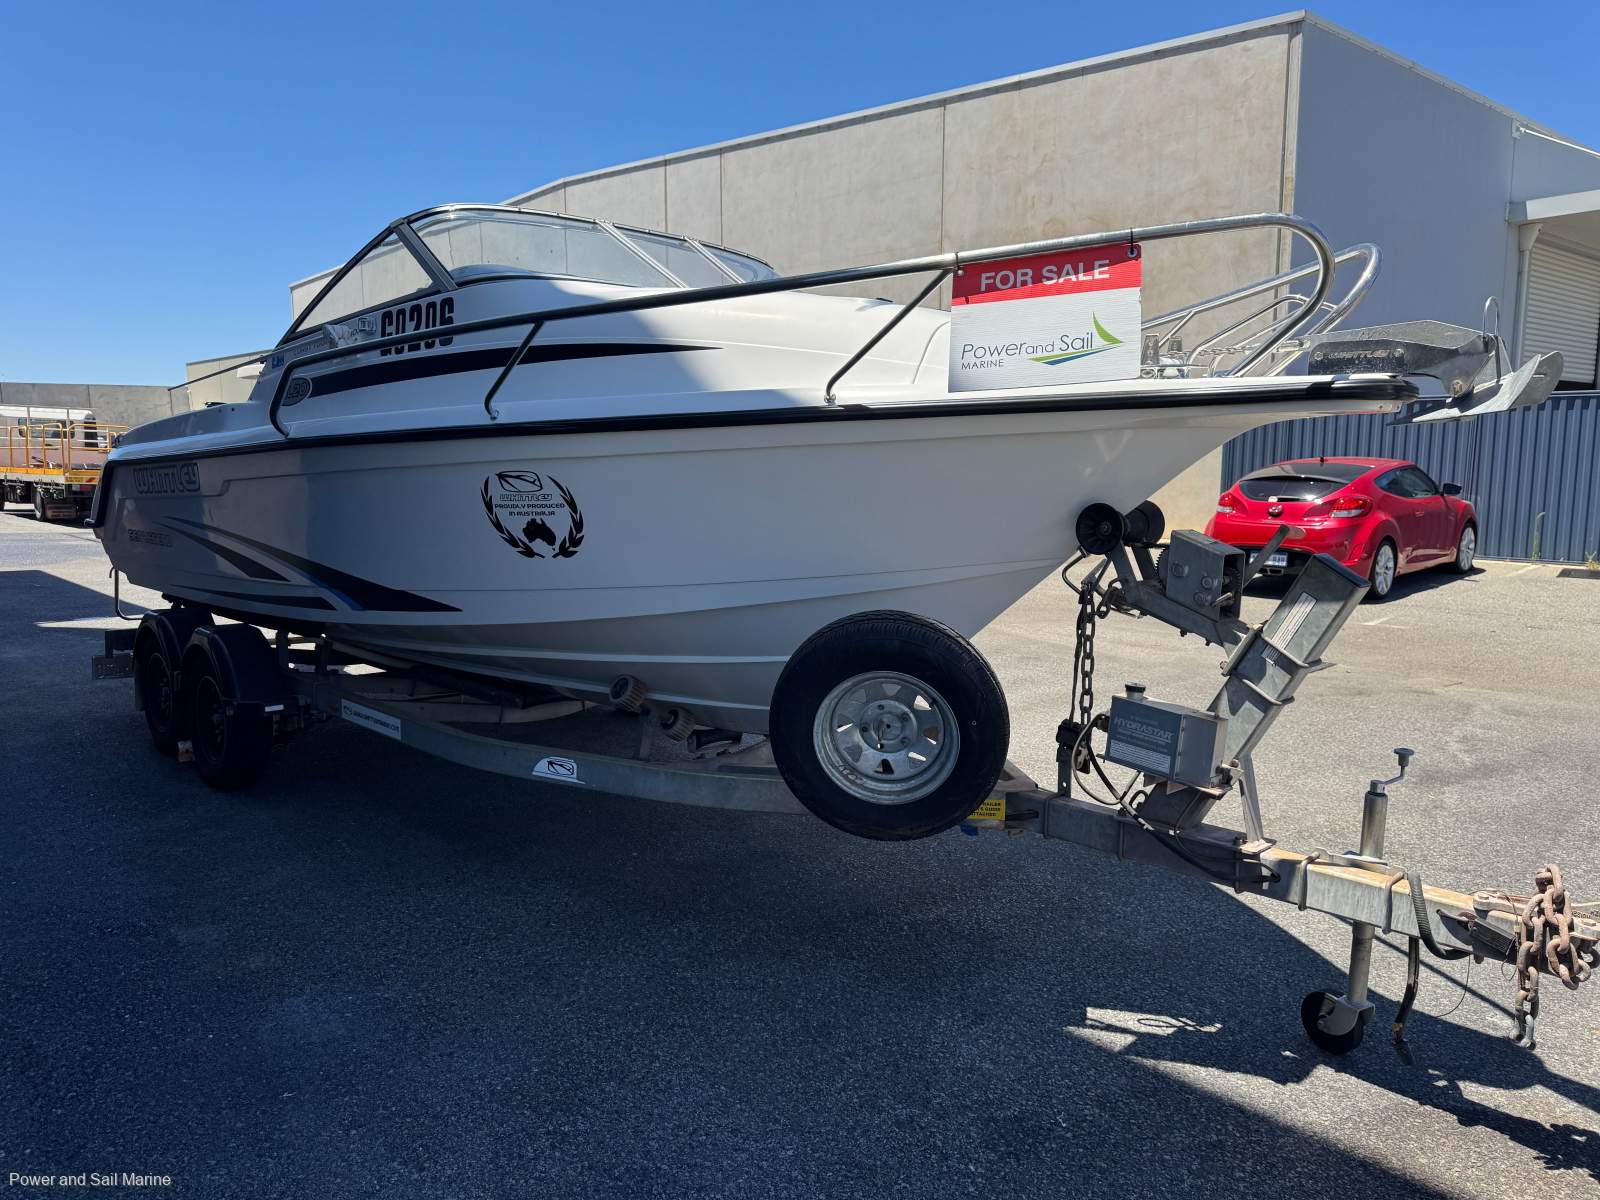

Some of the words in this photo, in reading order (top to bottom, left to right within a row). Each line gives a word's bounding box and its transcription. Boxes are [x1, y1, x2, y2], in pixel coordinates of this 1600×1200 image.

[980, 268, 1033, 292] FOR
[1041, 259, 1110, 285] SALE
[961, 342, 1026, 361] Power
[1026, 340, 1055, 355] and
[1059, 331, 1093, 352] Sail
[961, 358, 1004, 371] MARINE
[133, 462, 200, 495] WHITTLEY
[499, 493, 553, 502] WHITTLEY
